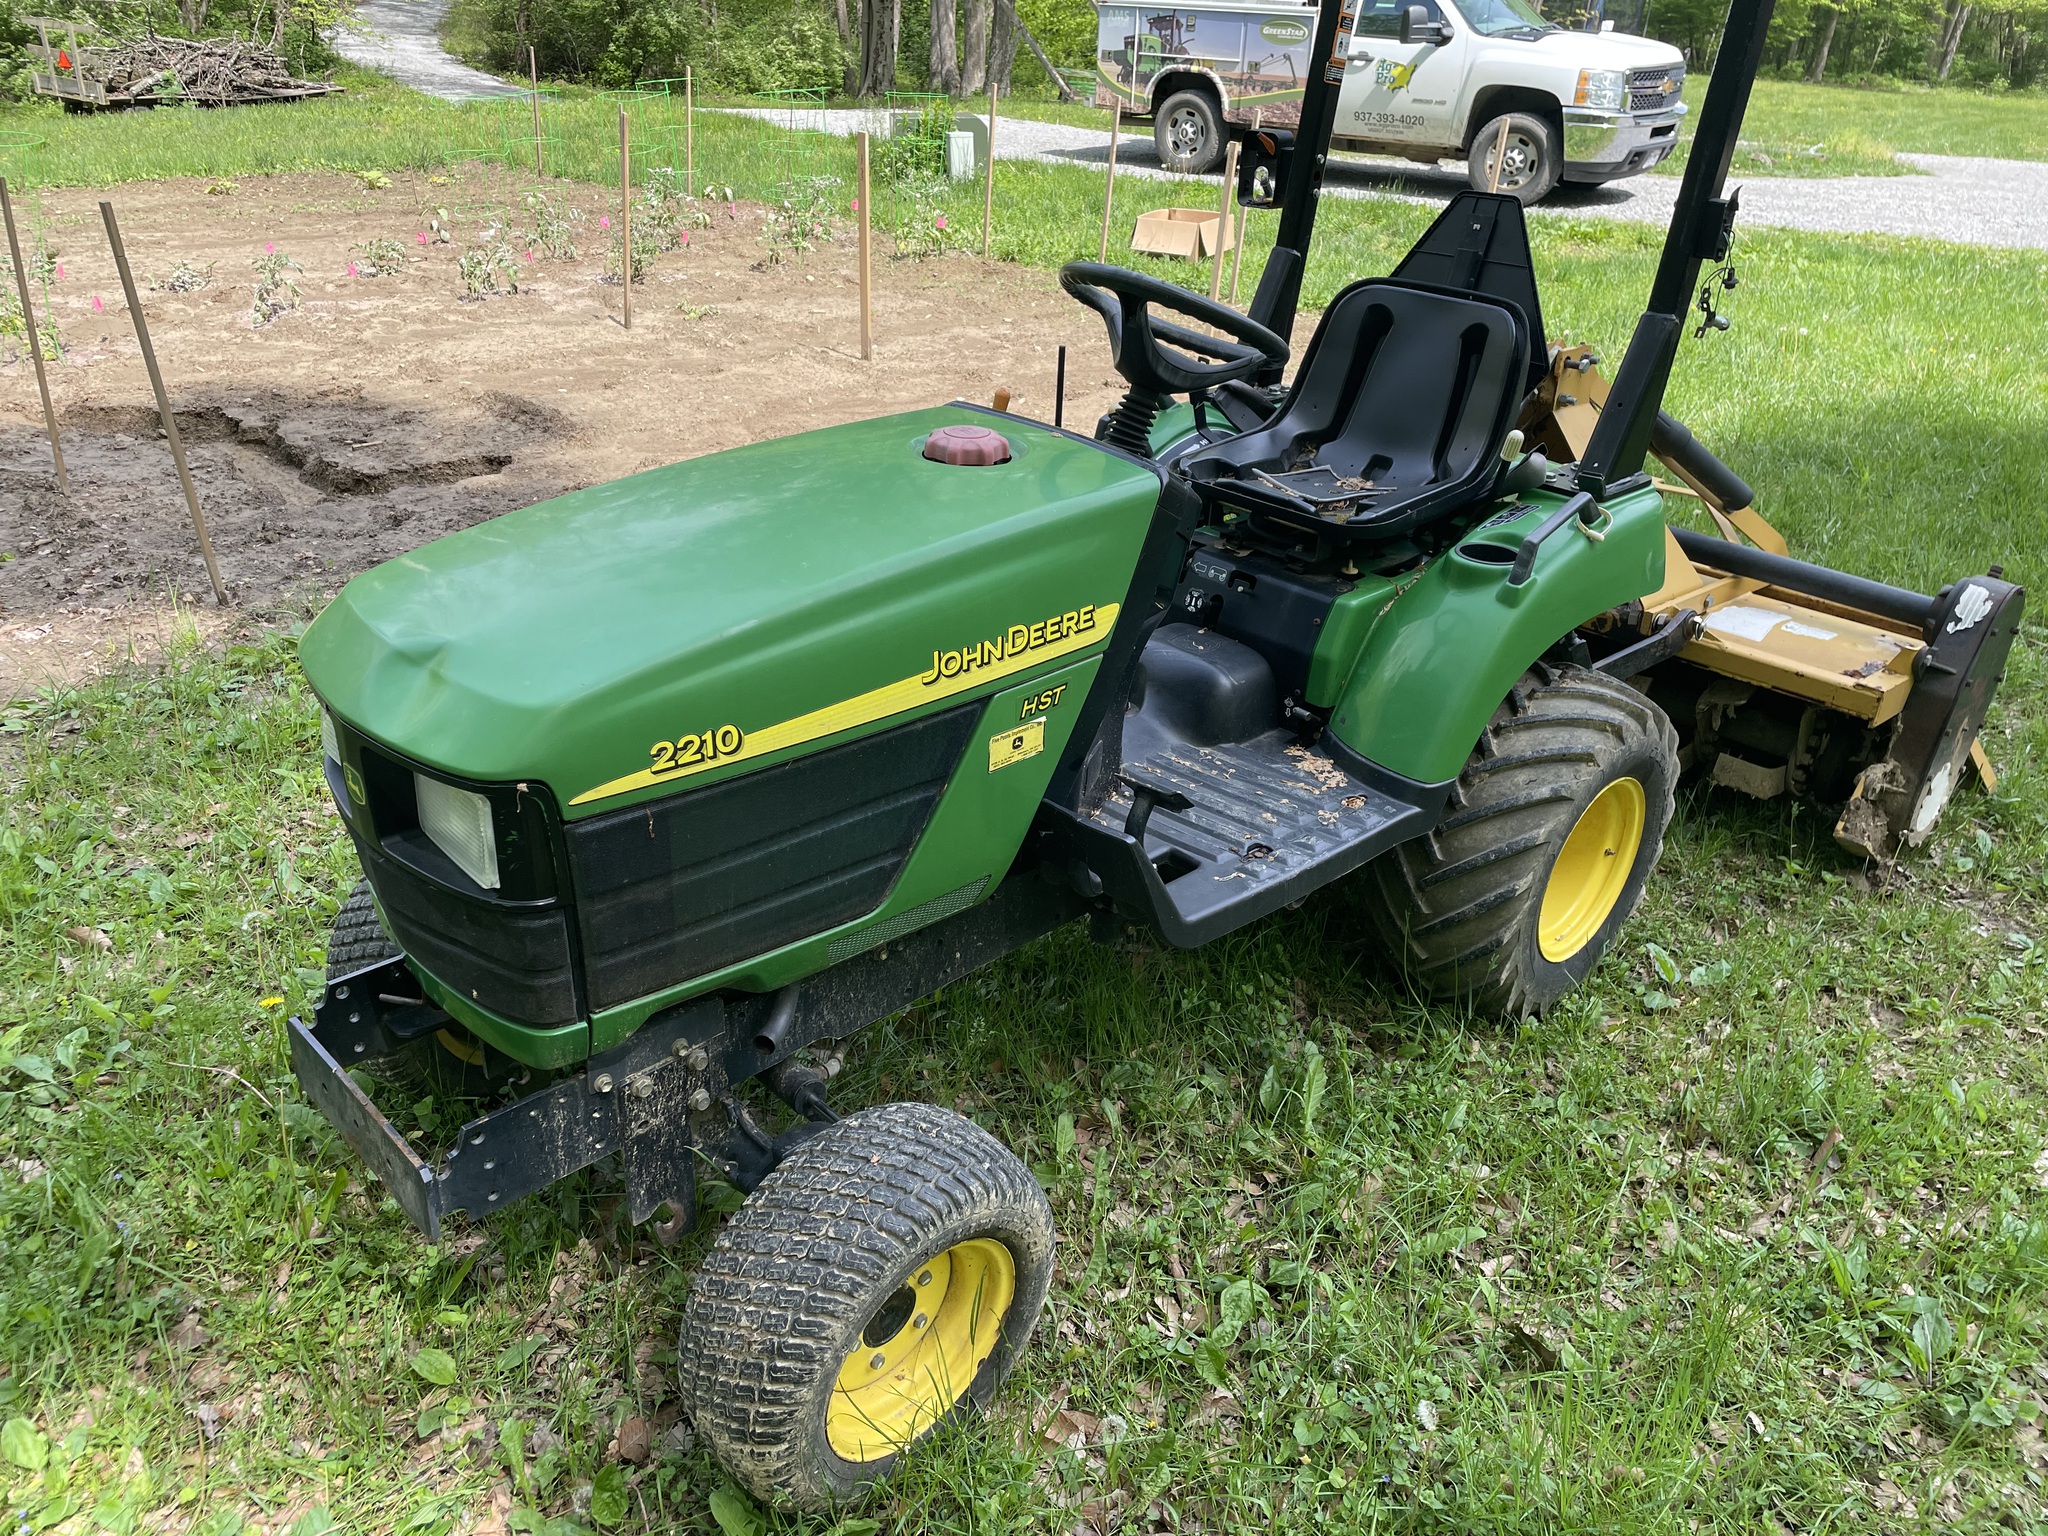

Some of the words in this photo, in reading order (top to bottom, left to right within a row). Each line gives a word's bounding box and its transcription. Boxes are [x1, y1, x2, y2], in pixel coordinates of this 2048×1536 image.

[1375, 72, 1395, 84] Pro
[1354, 111, 1425, 126] 937-393-4020
[922, 635, 1004, 686] JOHN
[1007, 604, 1096, 657] DEERE
[1019, 682, 1068, 721] HST
[650, 723, 743, 775] 2210
